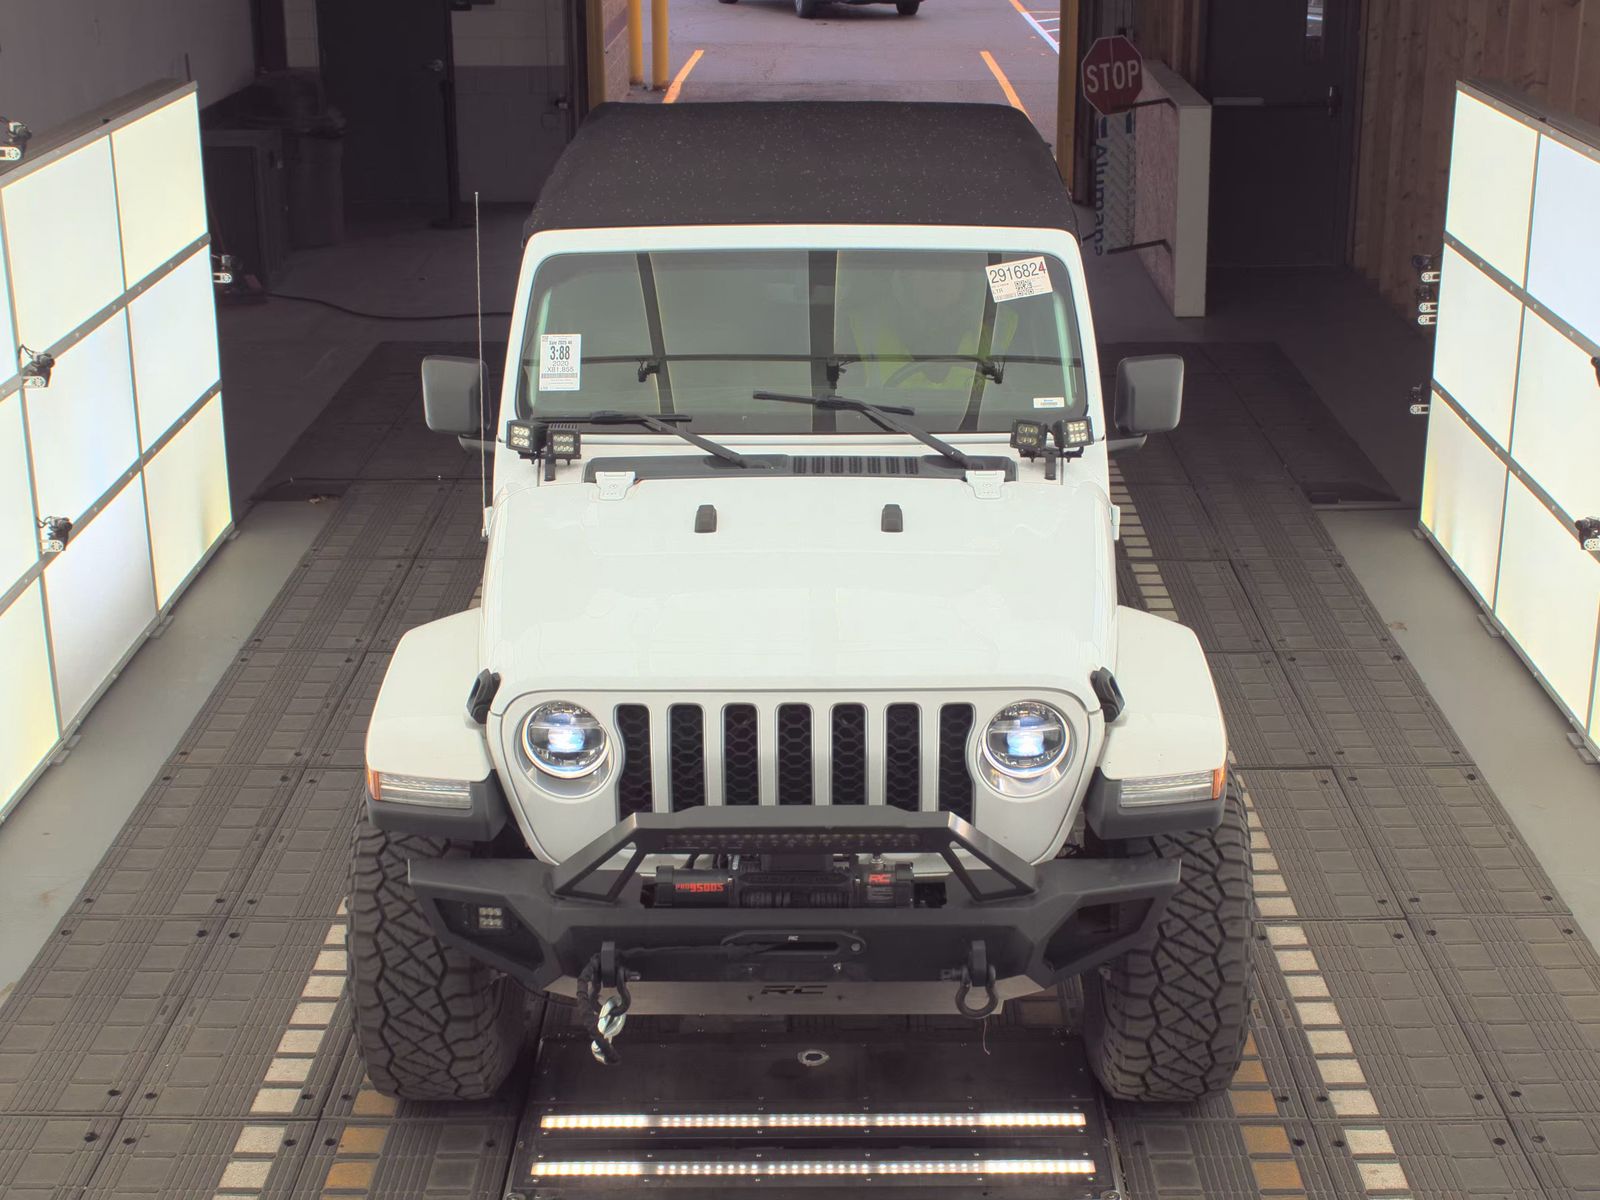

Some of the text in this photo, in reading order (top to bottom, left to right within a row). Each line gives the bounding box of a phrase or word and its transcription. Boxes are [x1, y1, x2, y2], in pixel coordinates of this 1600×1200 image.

[1086, 60, 1140, 93] STOP
[989, 261, 1046, 284] 2916824
[550, 345, 570, 360] 3:88
[868, 873, 892, 885] RC
